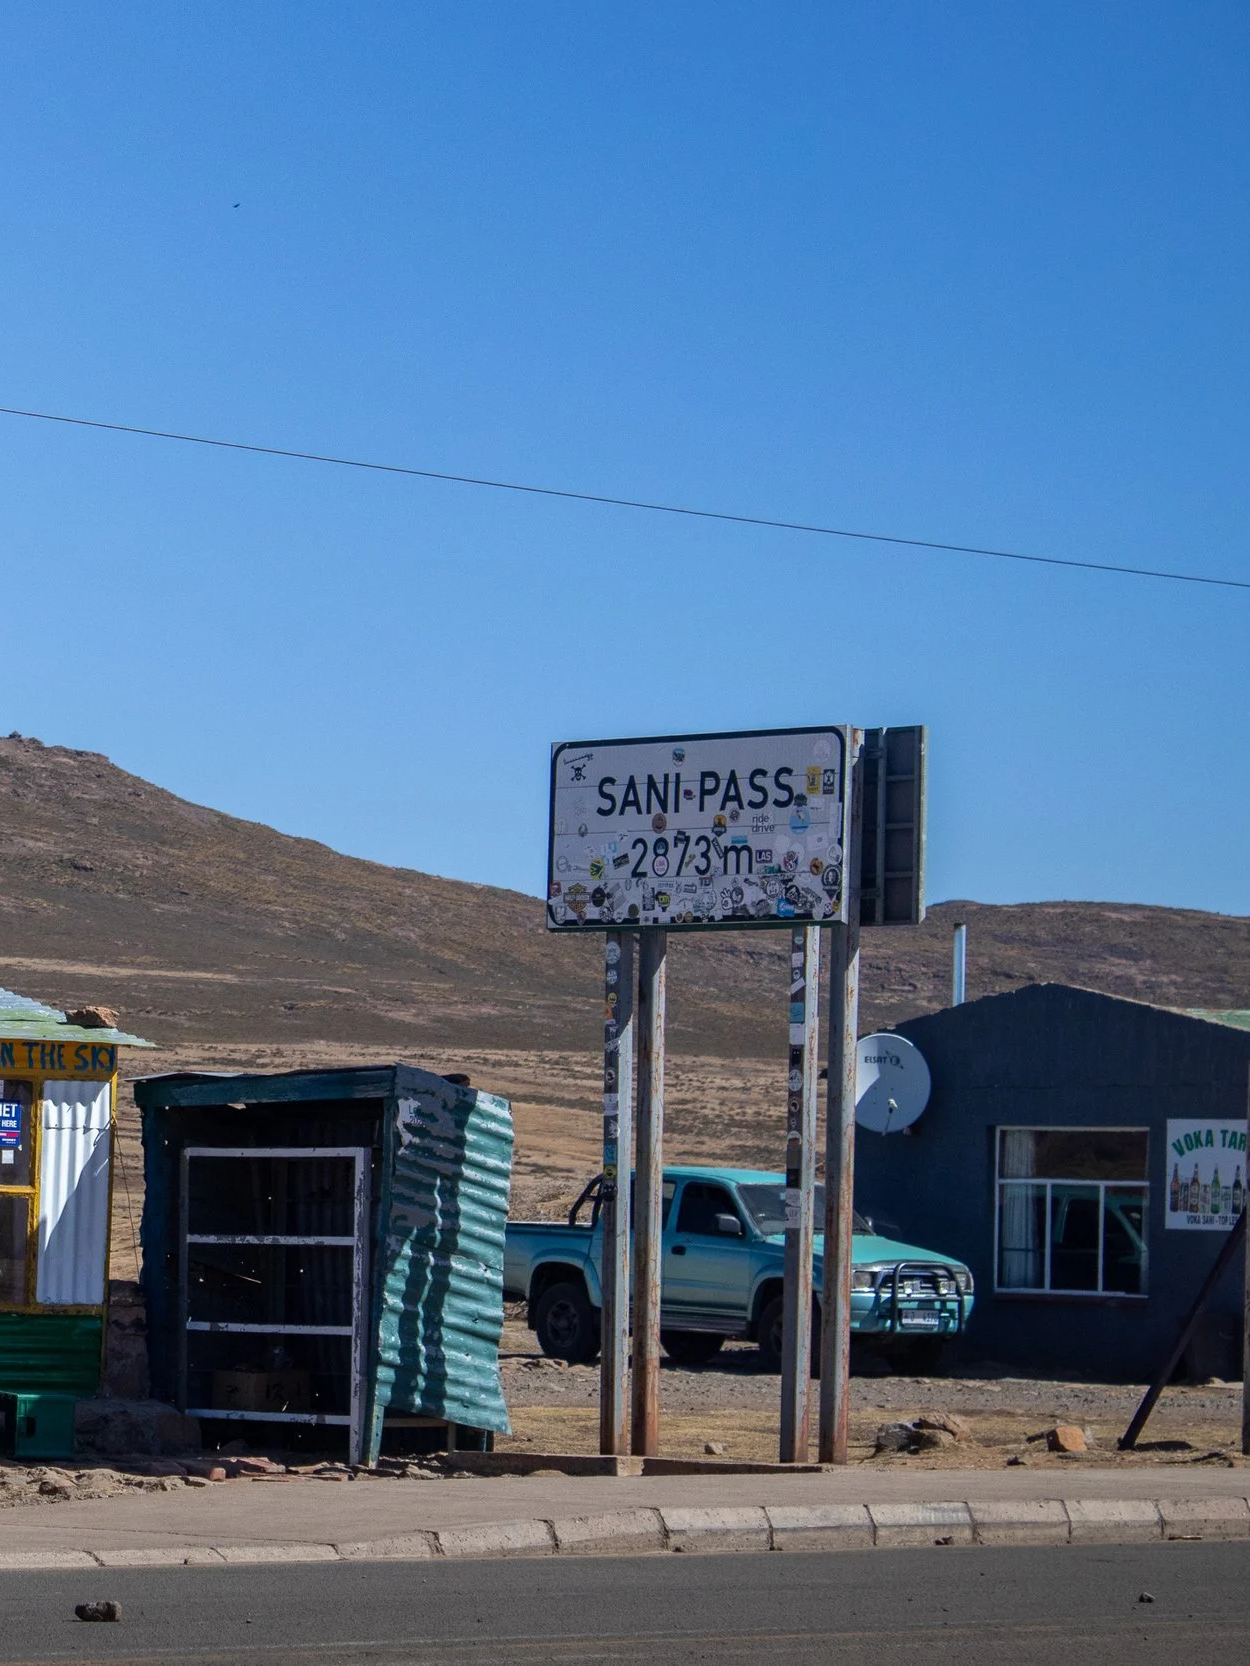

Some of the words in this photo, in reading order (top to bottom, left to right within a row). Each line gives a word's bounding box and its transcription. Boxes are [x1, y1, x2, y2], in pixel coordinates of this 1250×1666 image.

[596, 772, 681, 817] SANI
[698, 767, 795, 811] PASS
[751, 823, 775, 832] drive
[752, 813, 769, 823] ride
[21, 1041, 65, 1070] THE
[2, 1119, 17, 1128] HERE
[1171, 1129, 1214, 1157] VOKA
